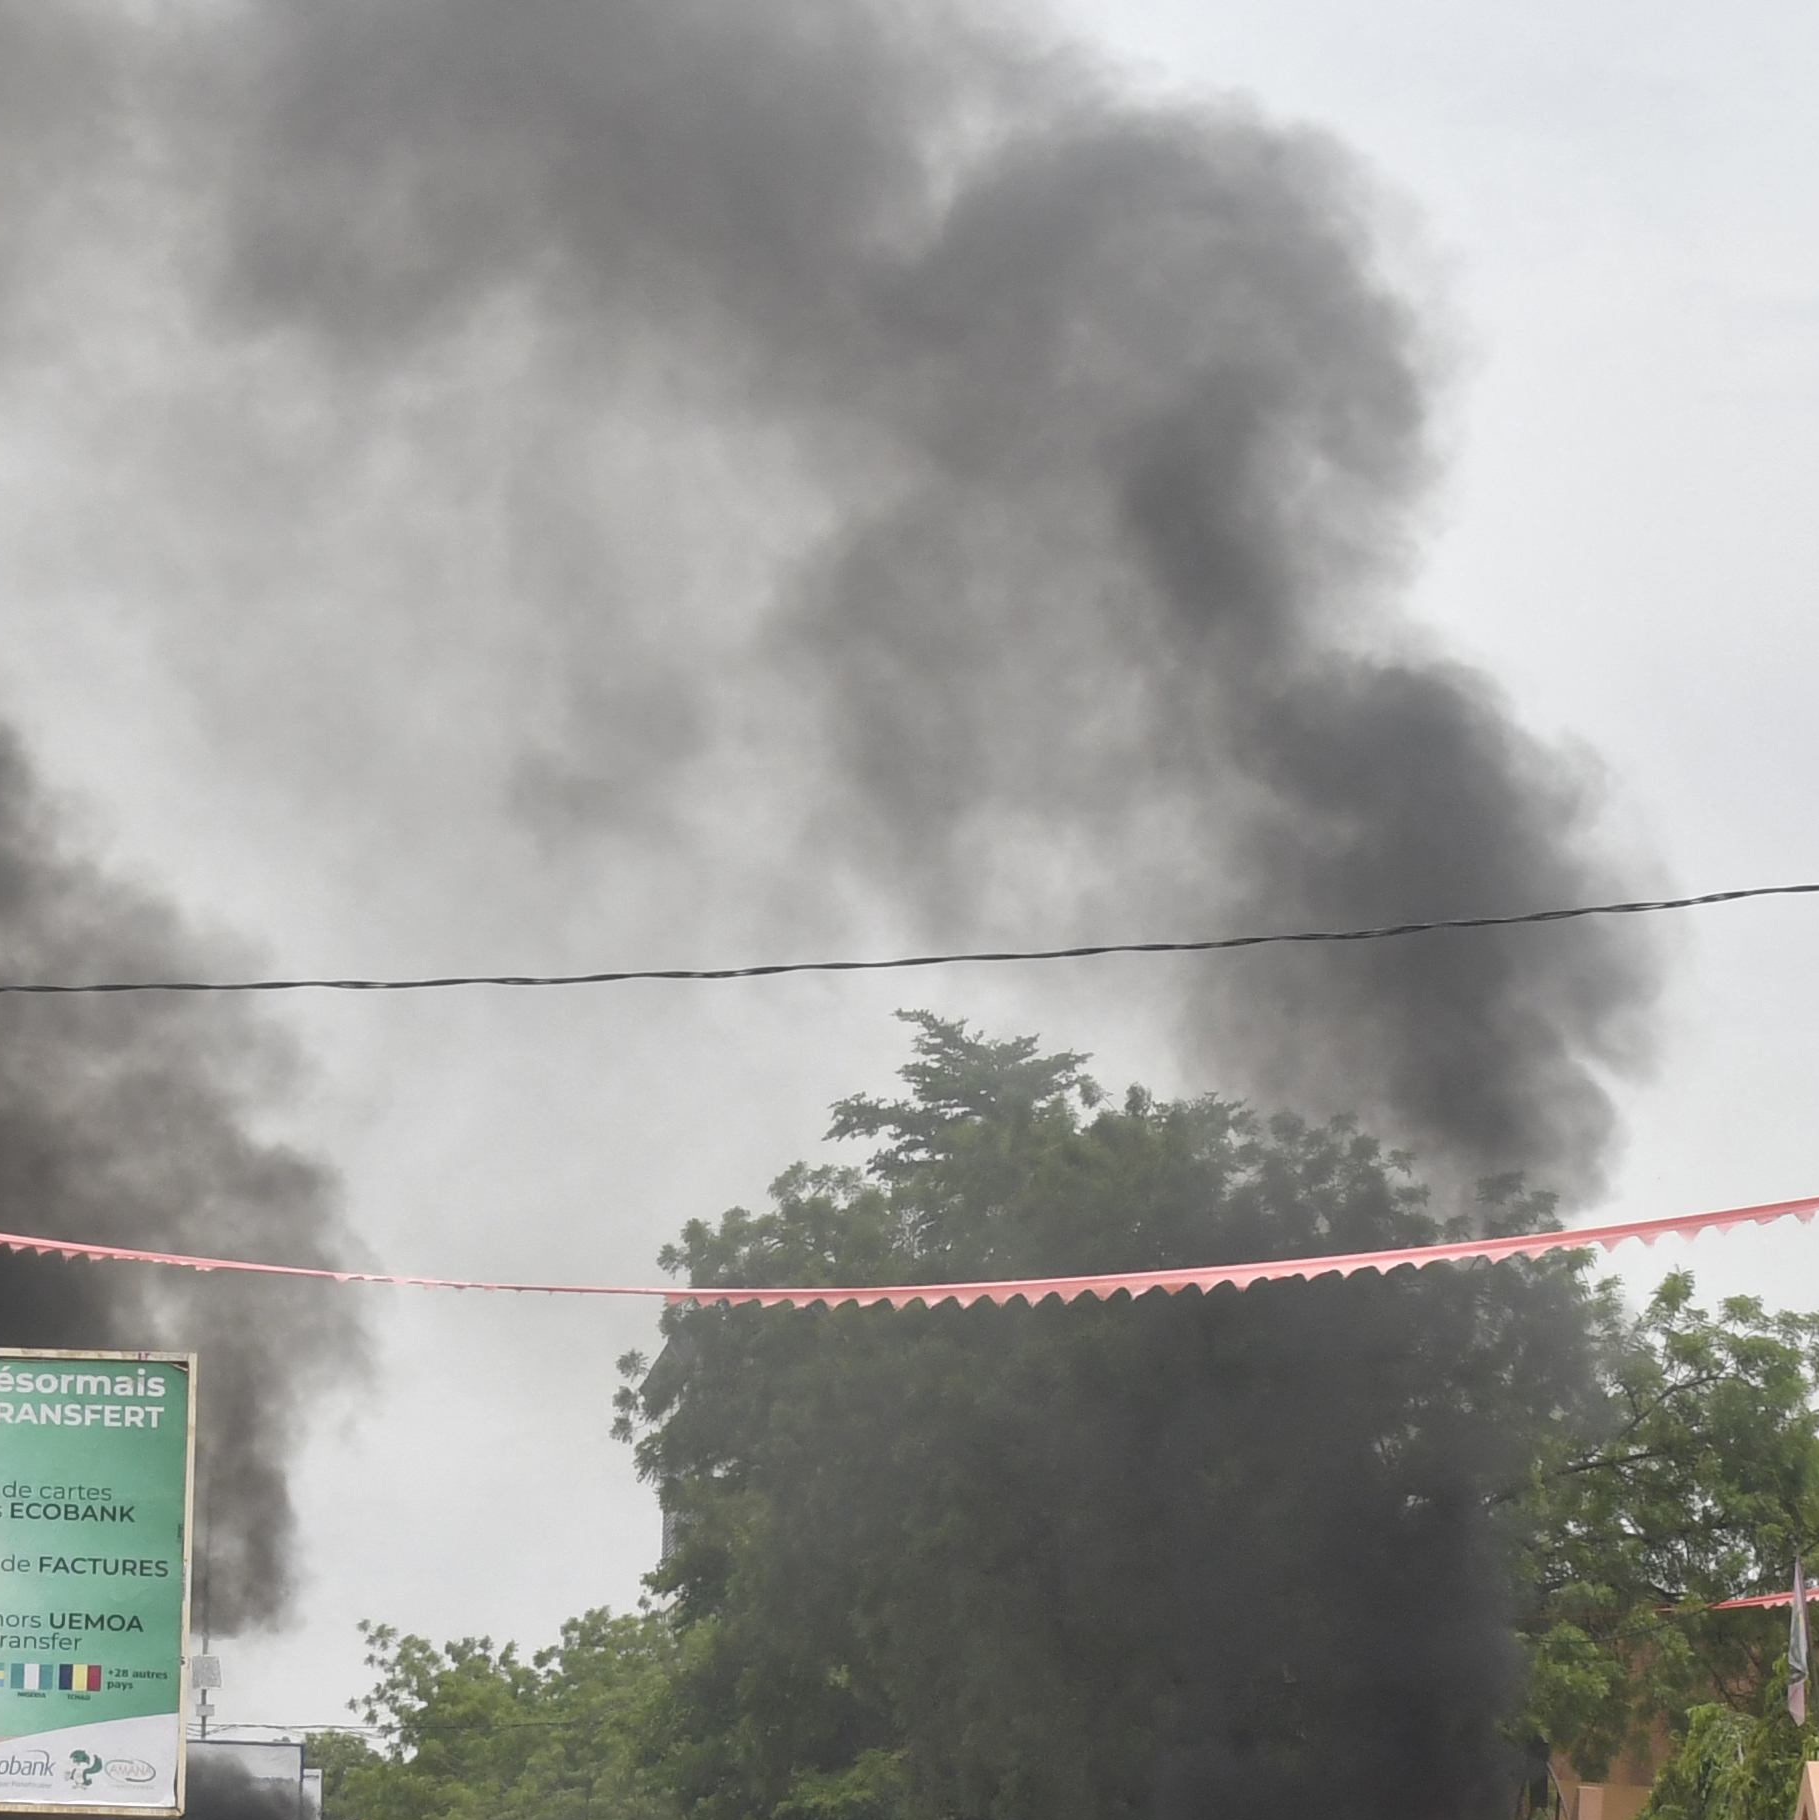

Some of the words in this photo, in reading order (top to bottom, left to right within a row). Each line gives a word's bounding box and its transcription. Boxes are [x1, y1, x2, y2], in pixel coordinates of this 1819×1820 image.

[2, 1480, 32, 1498] de
[39, 1483, 112, 1501] cartes
[9, 1502, 135, 1523] ECOBANK
[0, 1553, 31, 1572] de
[38, 1555, 169, 1578] FACTURES
[49, 1612, 144, 1633] UEMOA
[107, 1679, 134, 1690] pays
[108, 1668, 129, 1679] +28
[131, 1668, 168, 1680] autres
[109, 1764, 153, 1775] AMANA
